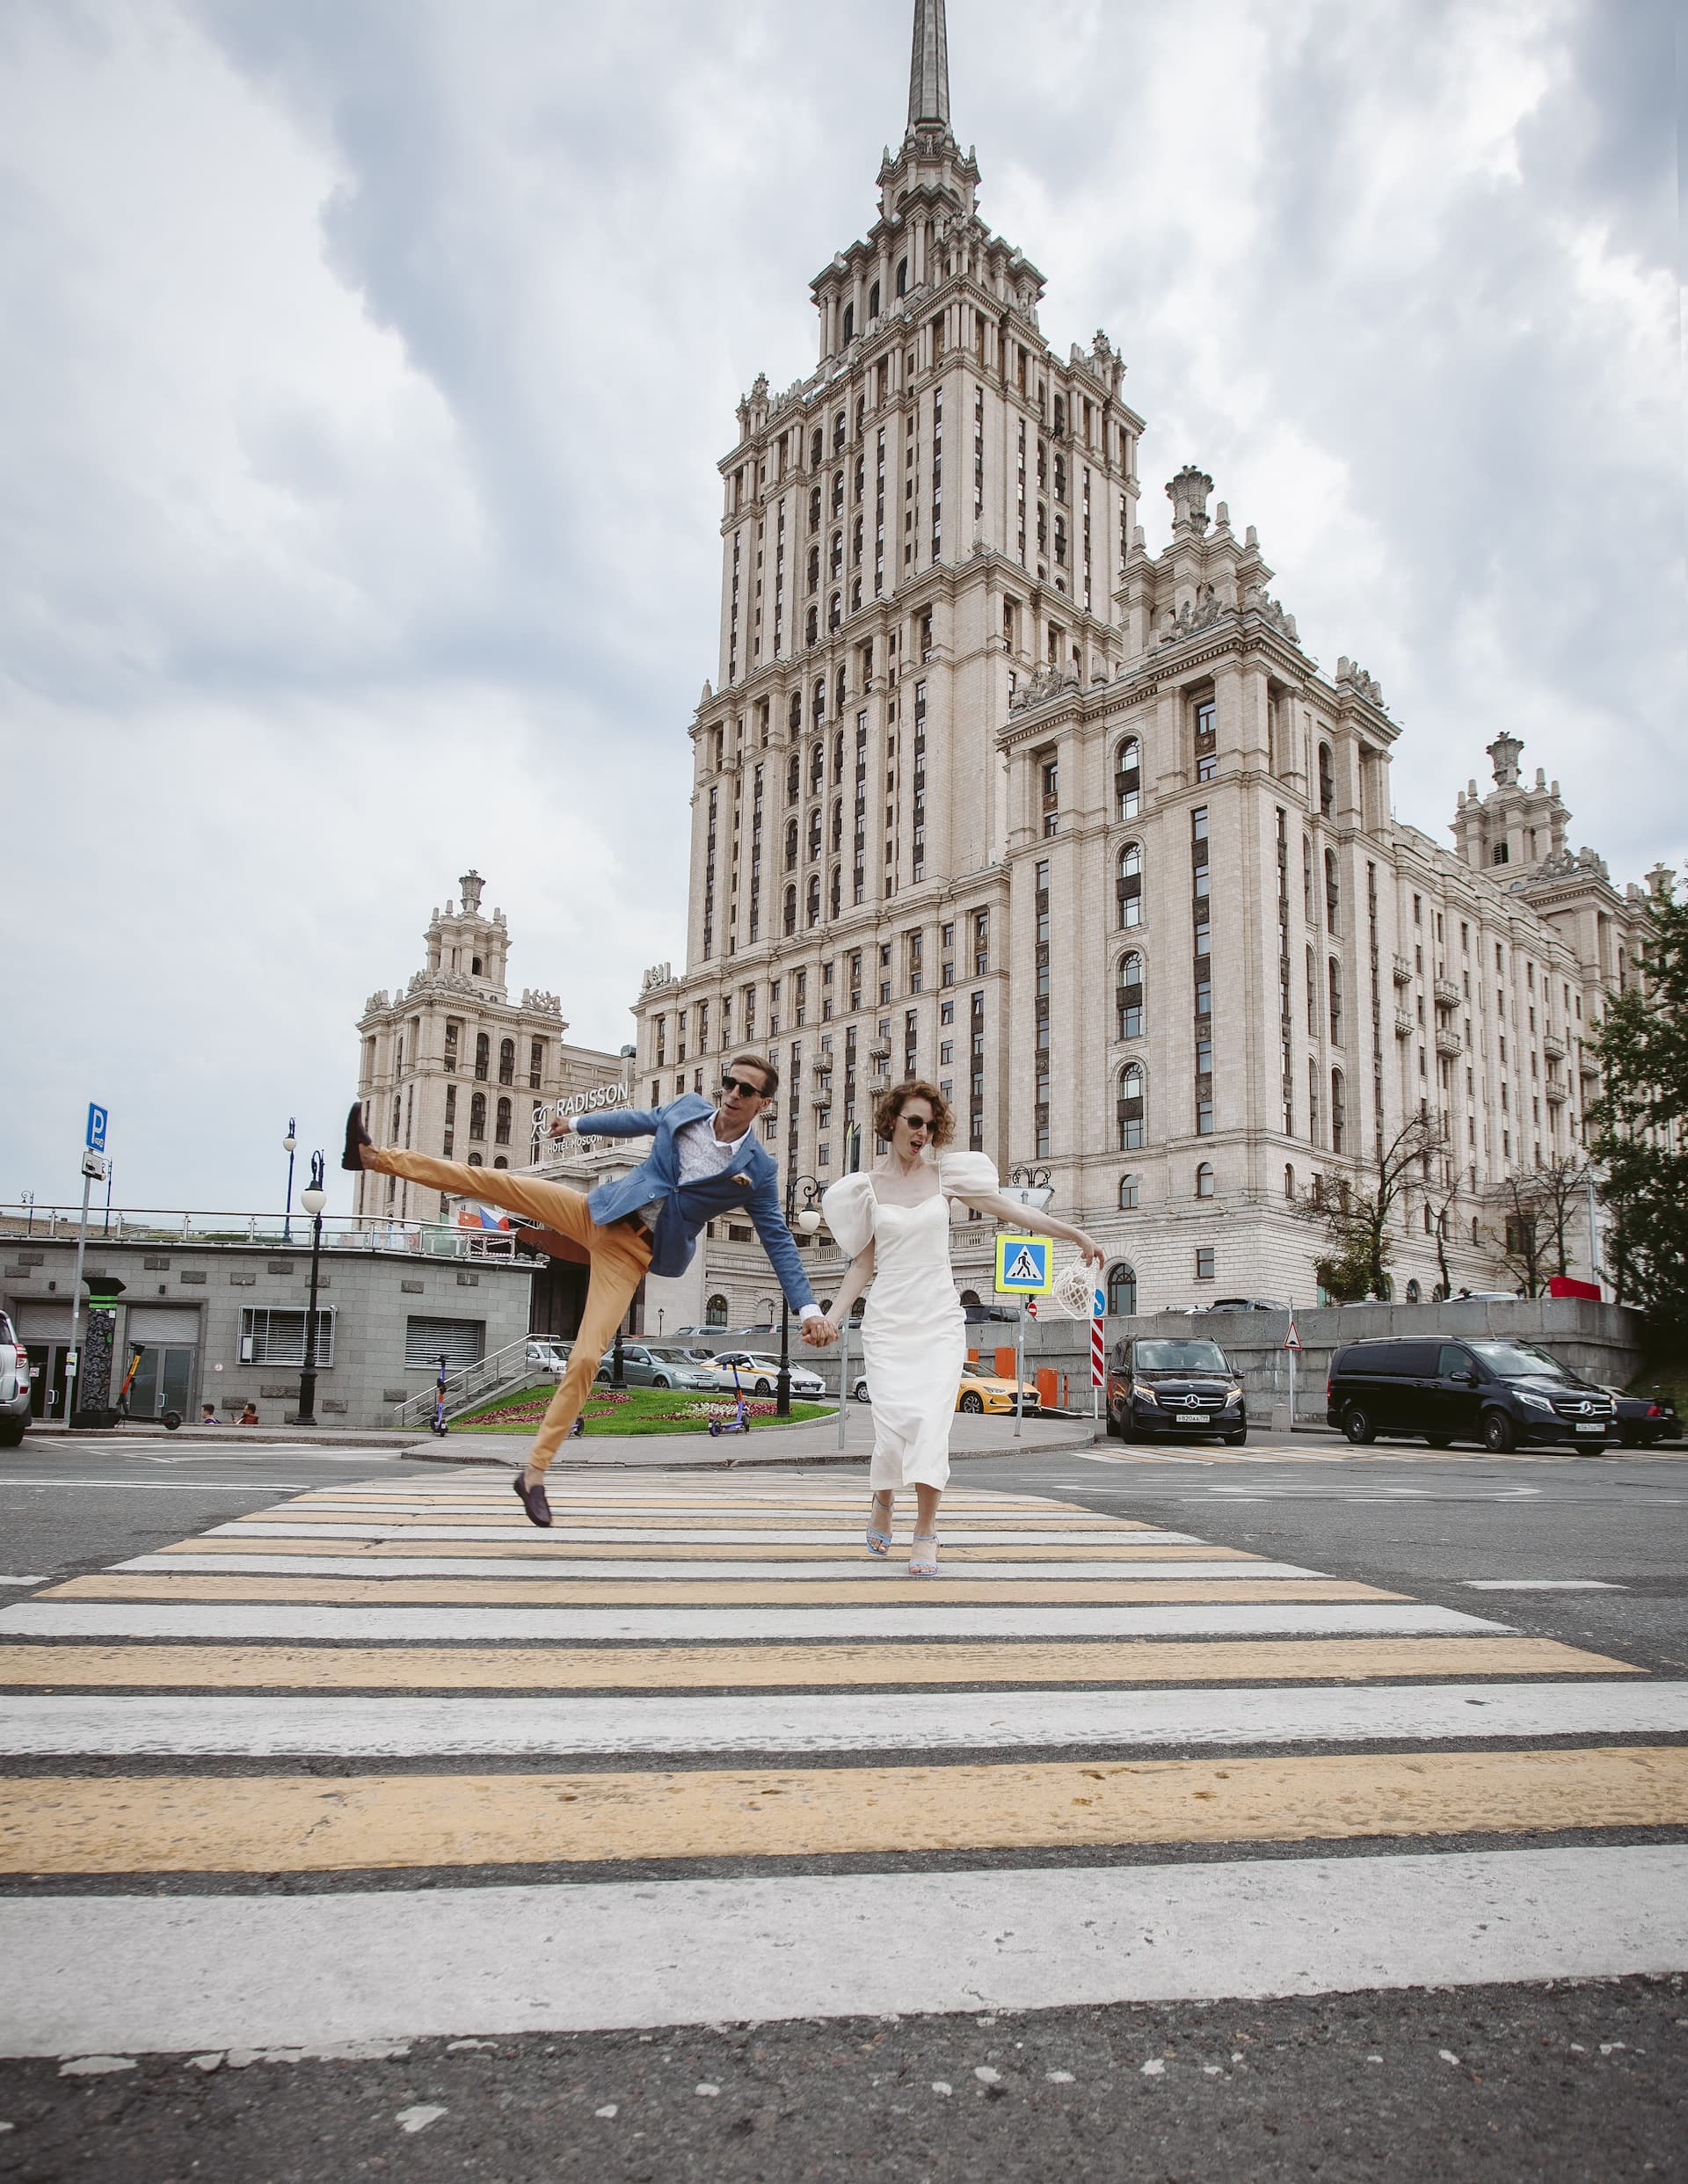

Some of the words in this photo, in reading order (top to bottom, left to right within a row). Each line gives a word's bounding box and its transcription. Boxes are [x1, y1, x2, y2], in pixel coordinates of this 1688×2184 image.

[557, 1081, 629, 1117] RADISSON
[91, 1109, 105, 1145] P
[549, 1140, 570, 1153] HOTEL
[571, 1134, 604, 1147] MOSCOW
